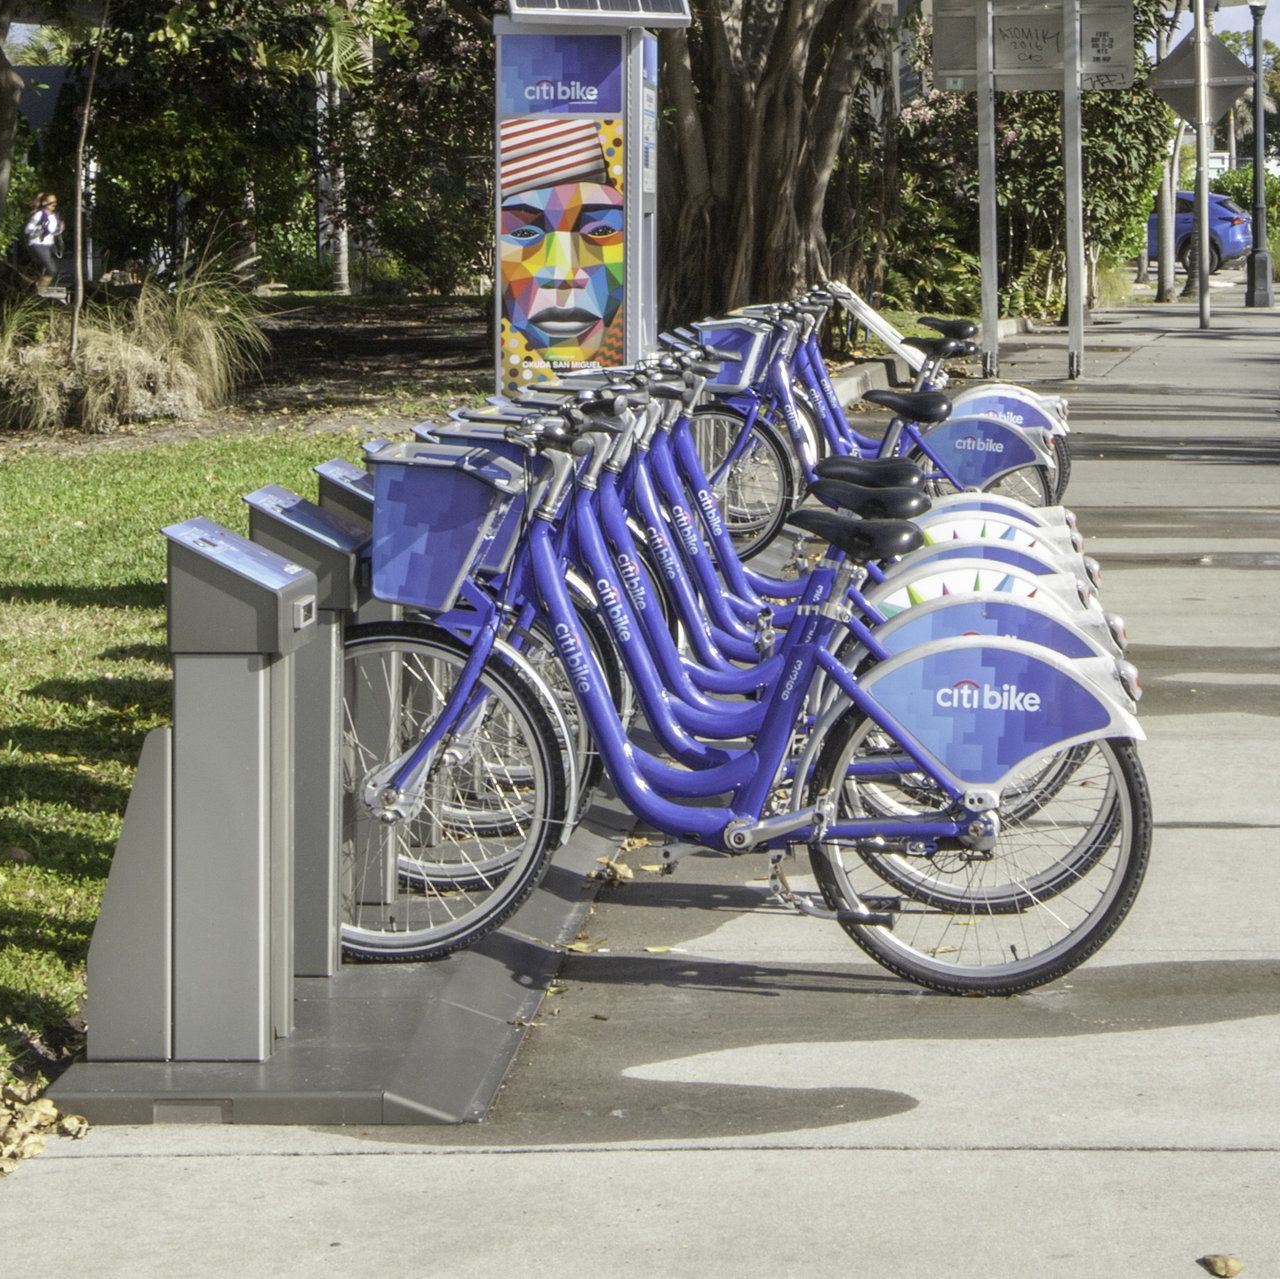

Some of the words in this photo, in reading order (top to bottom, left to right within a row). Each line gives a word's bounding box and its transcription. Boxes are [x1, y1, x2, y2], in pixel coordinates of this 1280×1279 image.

[522, 361, 551, 369] OKUDA
[553, 361, 570, 369] SAN
[572, 361, 601, 369] MIGUEL
[781, 659, 803, 701] 3366
